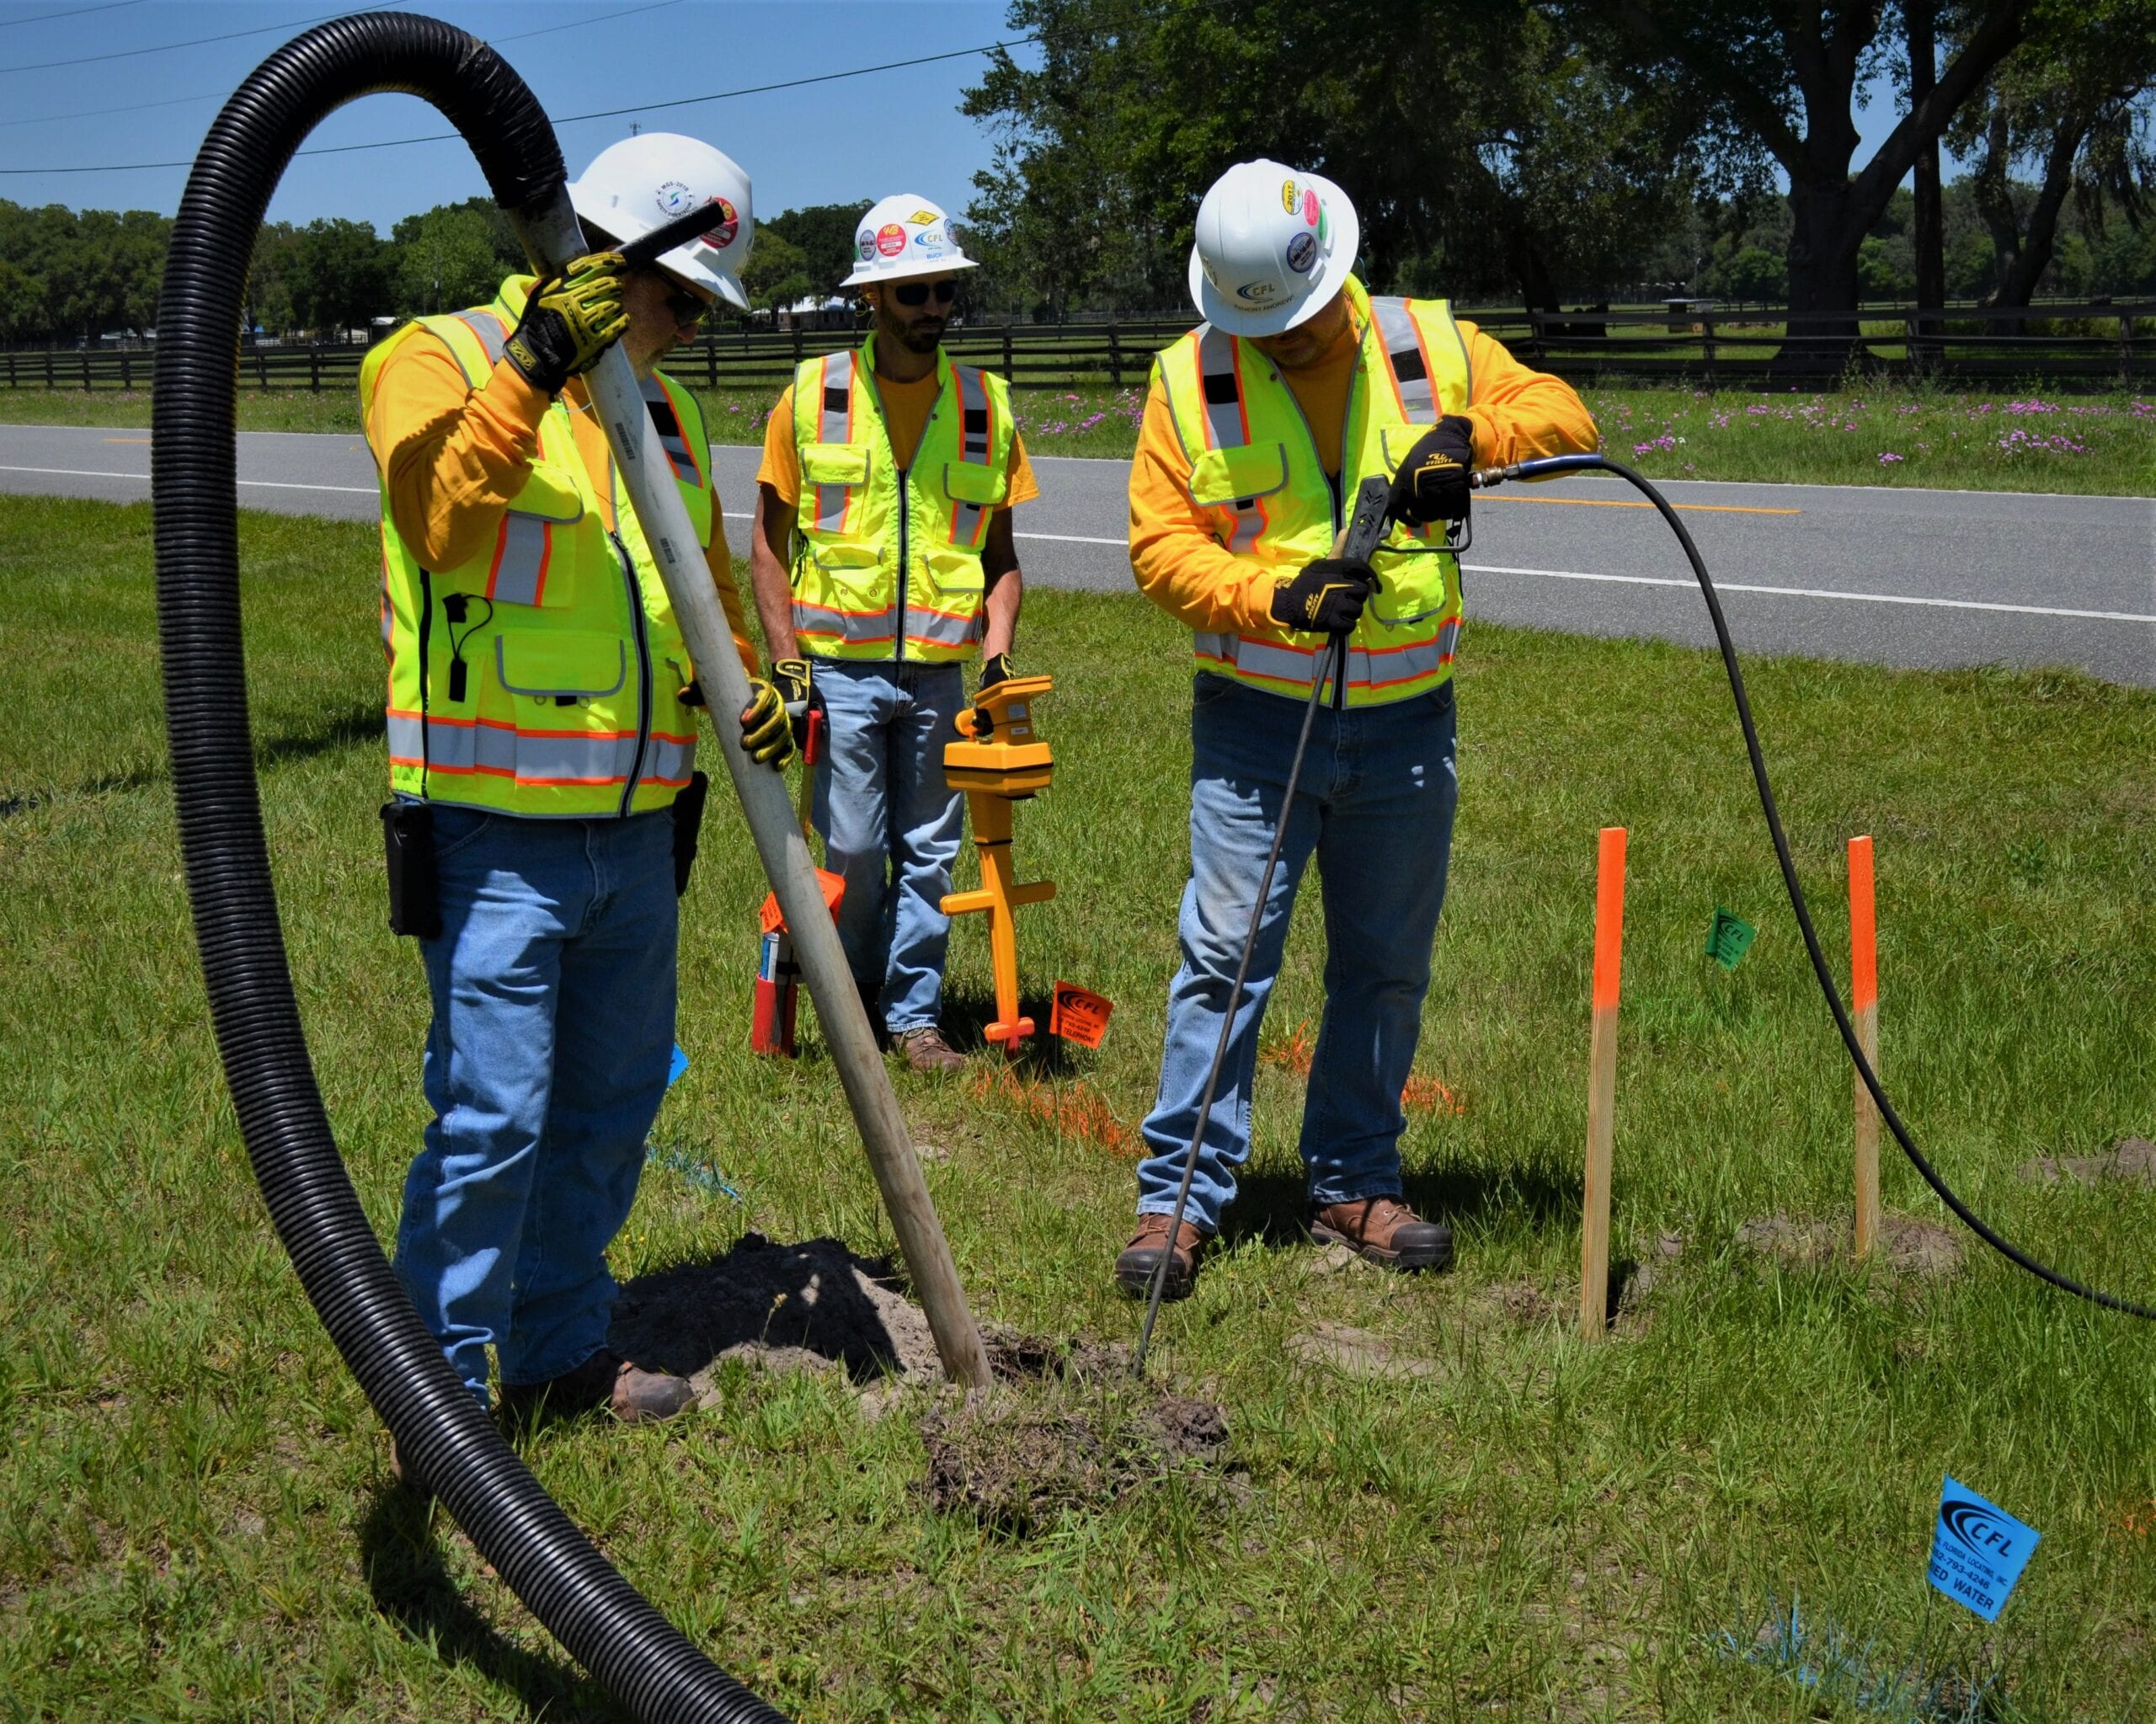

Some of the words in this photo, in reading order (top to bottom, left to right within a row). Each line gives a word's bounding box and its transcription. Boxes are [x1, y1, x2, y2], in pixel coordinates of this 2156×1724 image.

[927, 234, 943, 243] CFL
[1251, 283, 1275, 296] CFL
[1724, 925, 1743, 942] CFL
[1075, 999, 1099, 1015] CFL
[1065, 1027, 1096, 1043] TELEPHONE
[1971, 1523, 2012, 1557] CFL
[1933, 1548, 1990, 1590] 52-793-4246
[1942, 1541, 1967, 1561] FLORIDA
[1996, 1576, 2008, 1587] INC.
[1930, 1562, 1949, 1581] IED
[1953, 1577, 1994, 1611] WATER
